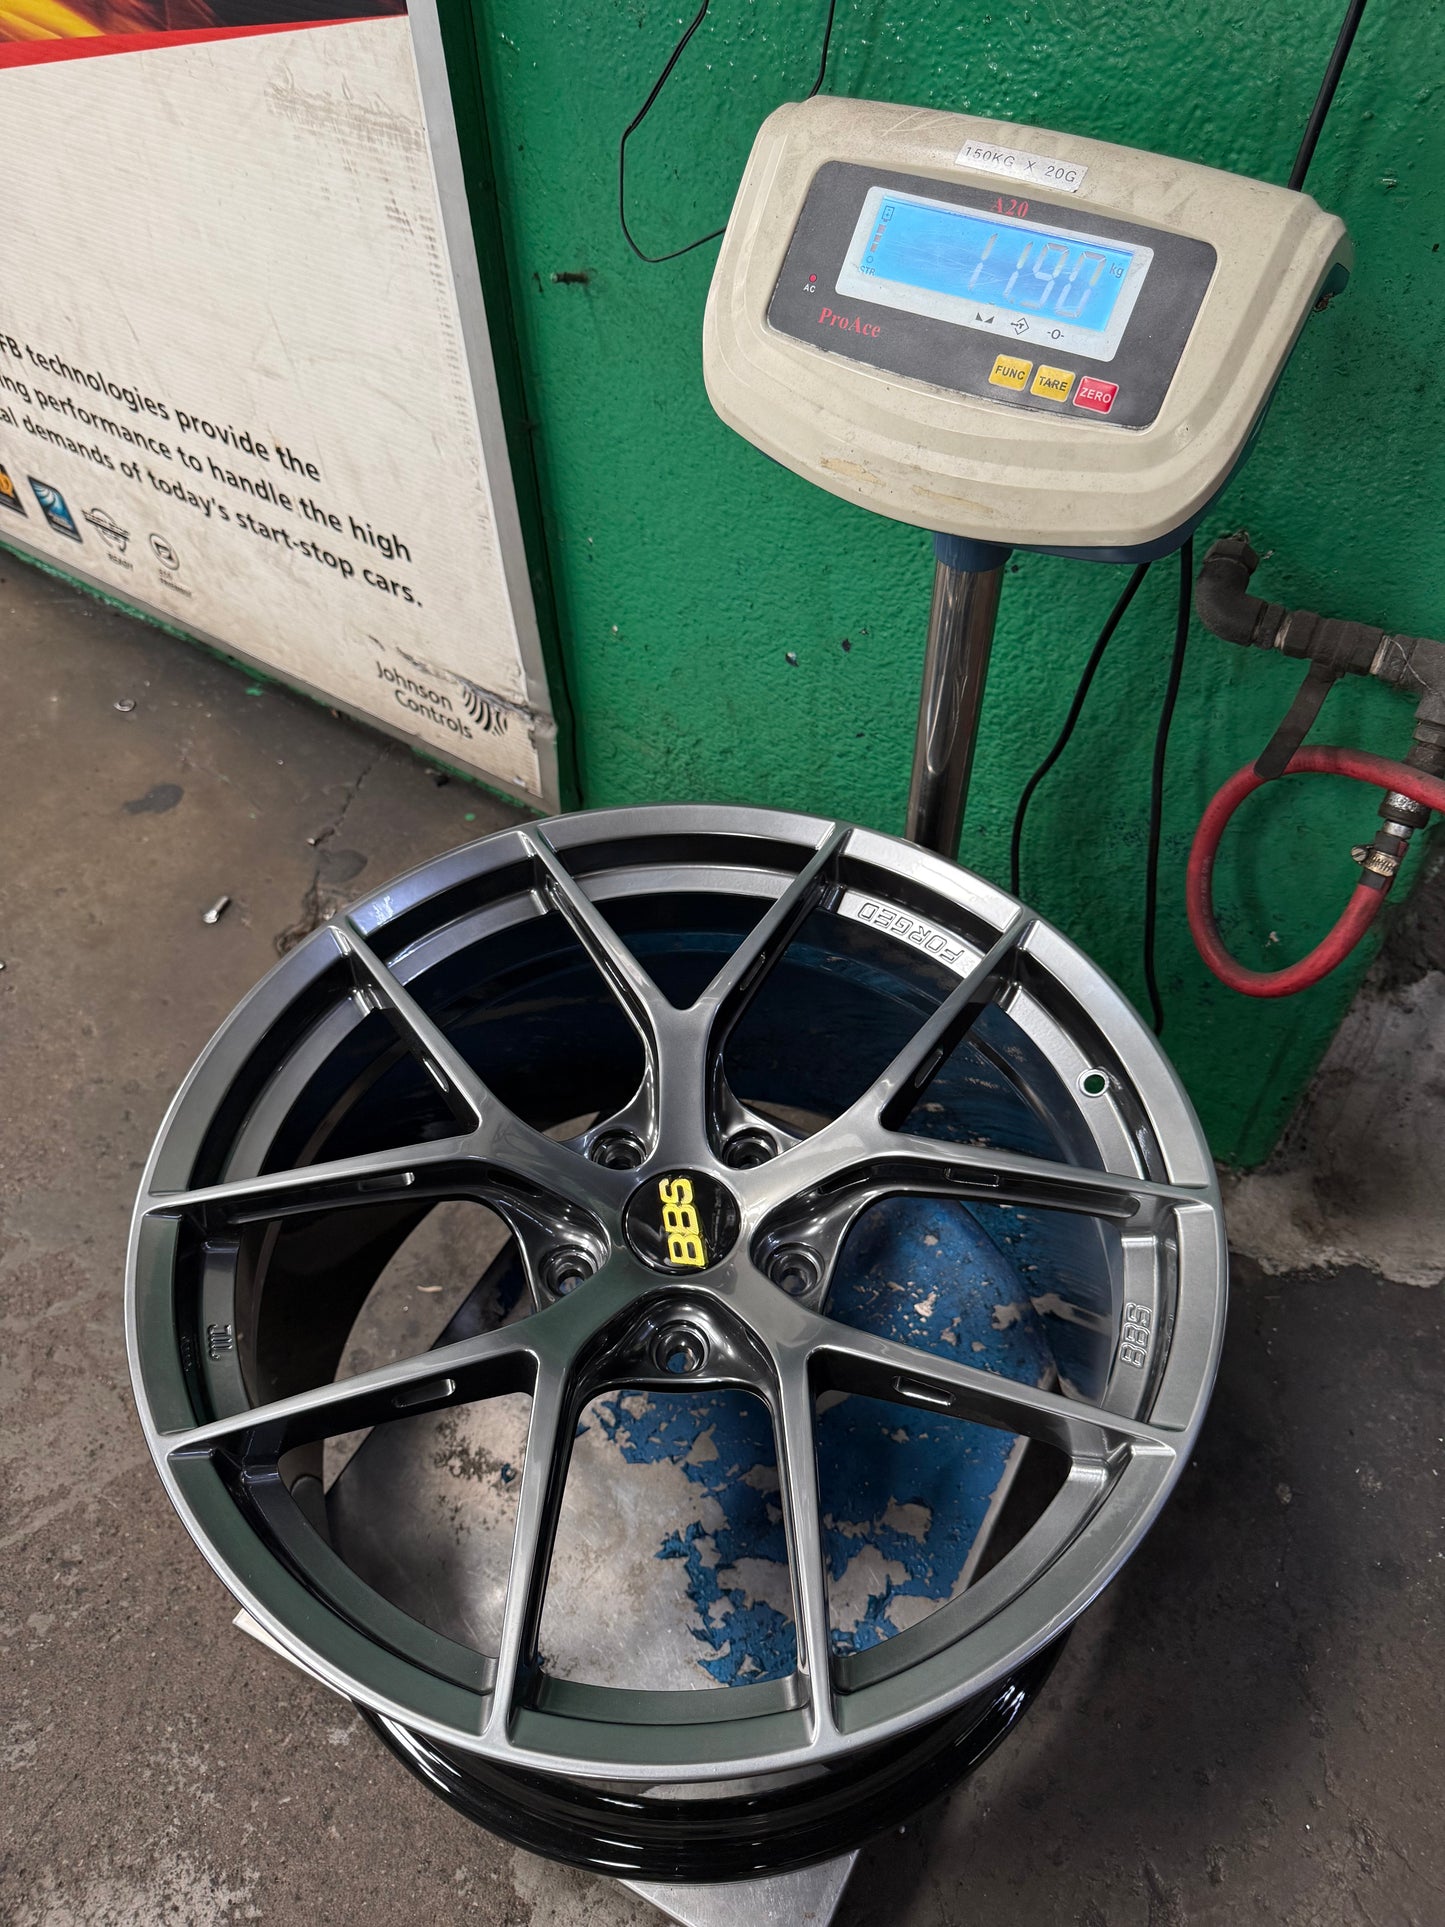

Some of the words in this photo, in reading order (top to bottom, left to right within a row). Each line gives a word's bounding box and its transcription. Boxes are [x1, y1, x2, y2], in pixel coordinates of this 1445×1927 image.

[965, 146, 1015, 168] 150KG
[1045, 165, 1077, 183] 20G
[990, 197, 1030, 219] A20
[803, 284, 816, 293] AC
[1108, 262, 1124, 278] kg
[818, 307, 881, 339] ProAce
[995, 364, 1026, 381] FUNC
[1038, 376, 1068, 392] TARE
[26, 344, 170, 421] technologies
[175, 408, 270, 461] provide
[276, 446, 321, 482] the
[1079, 387, 1112, 405] ZERO
[33, 387, 173, 461] performance
[177, 446, 202, 473] to
[208, 457, 293, 511] handle
[299, 498, 343, 533] the
[349, 516, 412, 563] high
[22, 414, 115, 470] demands
[120, 462, 143, 483] of
[148, 469, 229, 522] today's
[236, 510, 355, 579] start-stop
[363, 566, 423, 607] cars.
[376, 661, 453, 710] Johnson
[394, 690, 473, 739] Controls
[857, 902, 965, 965] FORGED
[658, 1178, 706, 1267] BBS
[1120, 1302, 1153, 1369] BBS
